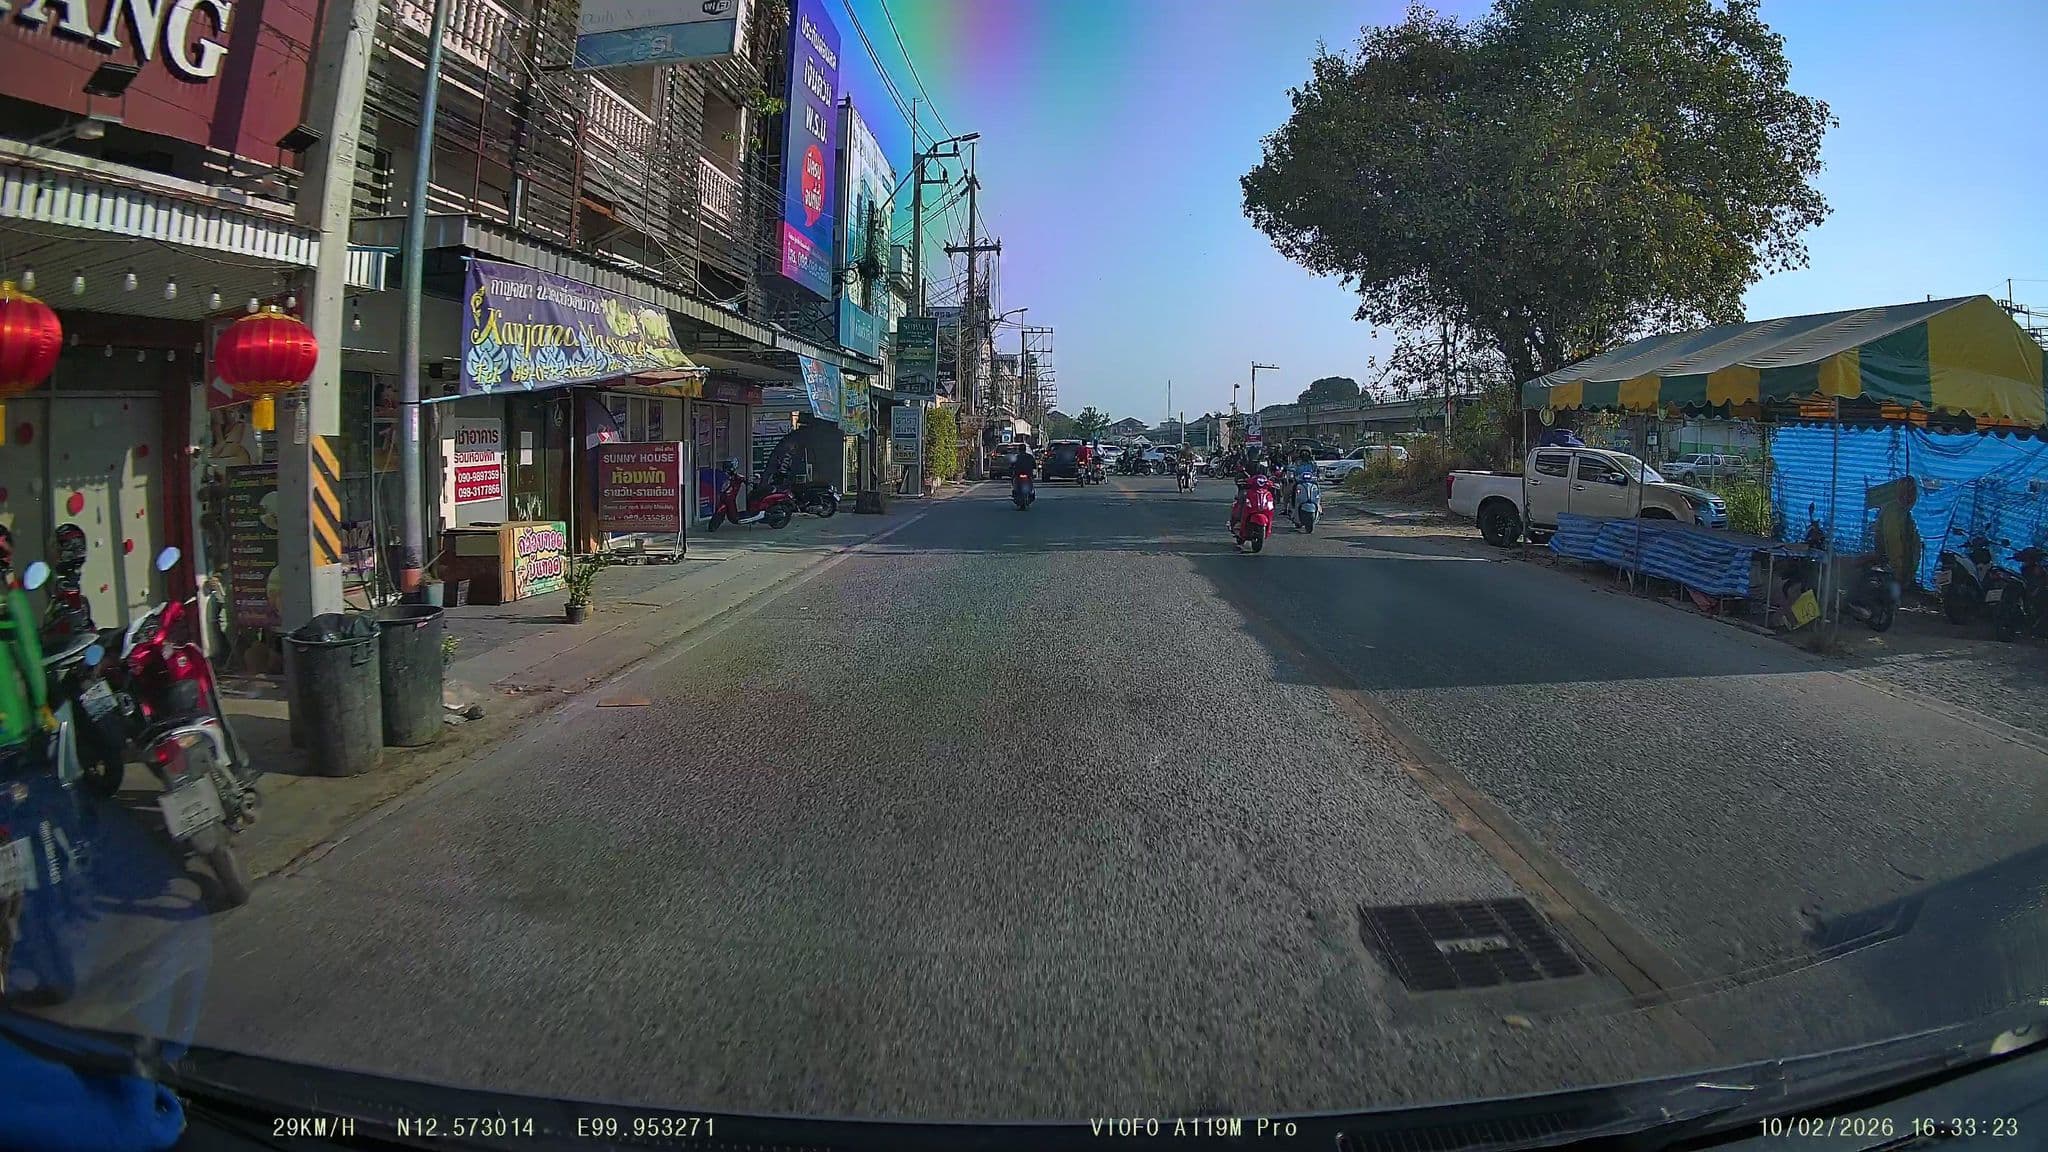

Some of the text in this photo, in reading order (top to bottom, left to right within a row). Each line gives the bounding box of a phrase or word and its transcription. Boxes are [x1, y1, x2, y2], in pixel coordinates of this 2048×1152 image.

[804, 55, 832, 108] เงินด่วน
[603, 453, 675, 464] SUNNY HOUSE
[611, 466, 666, 484] ห้องพัก
[604, 486, 675, 497] รายวัน-รายเดือน
